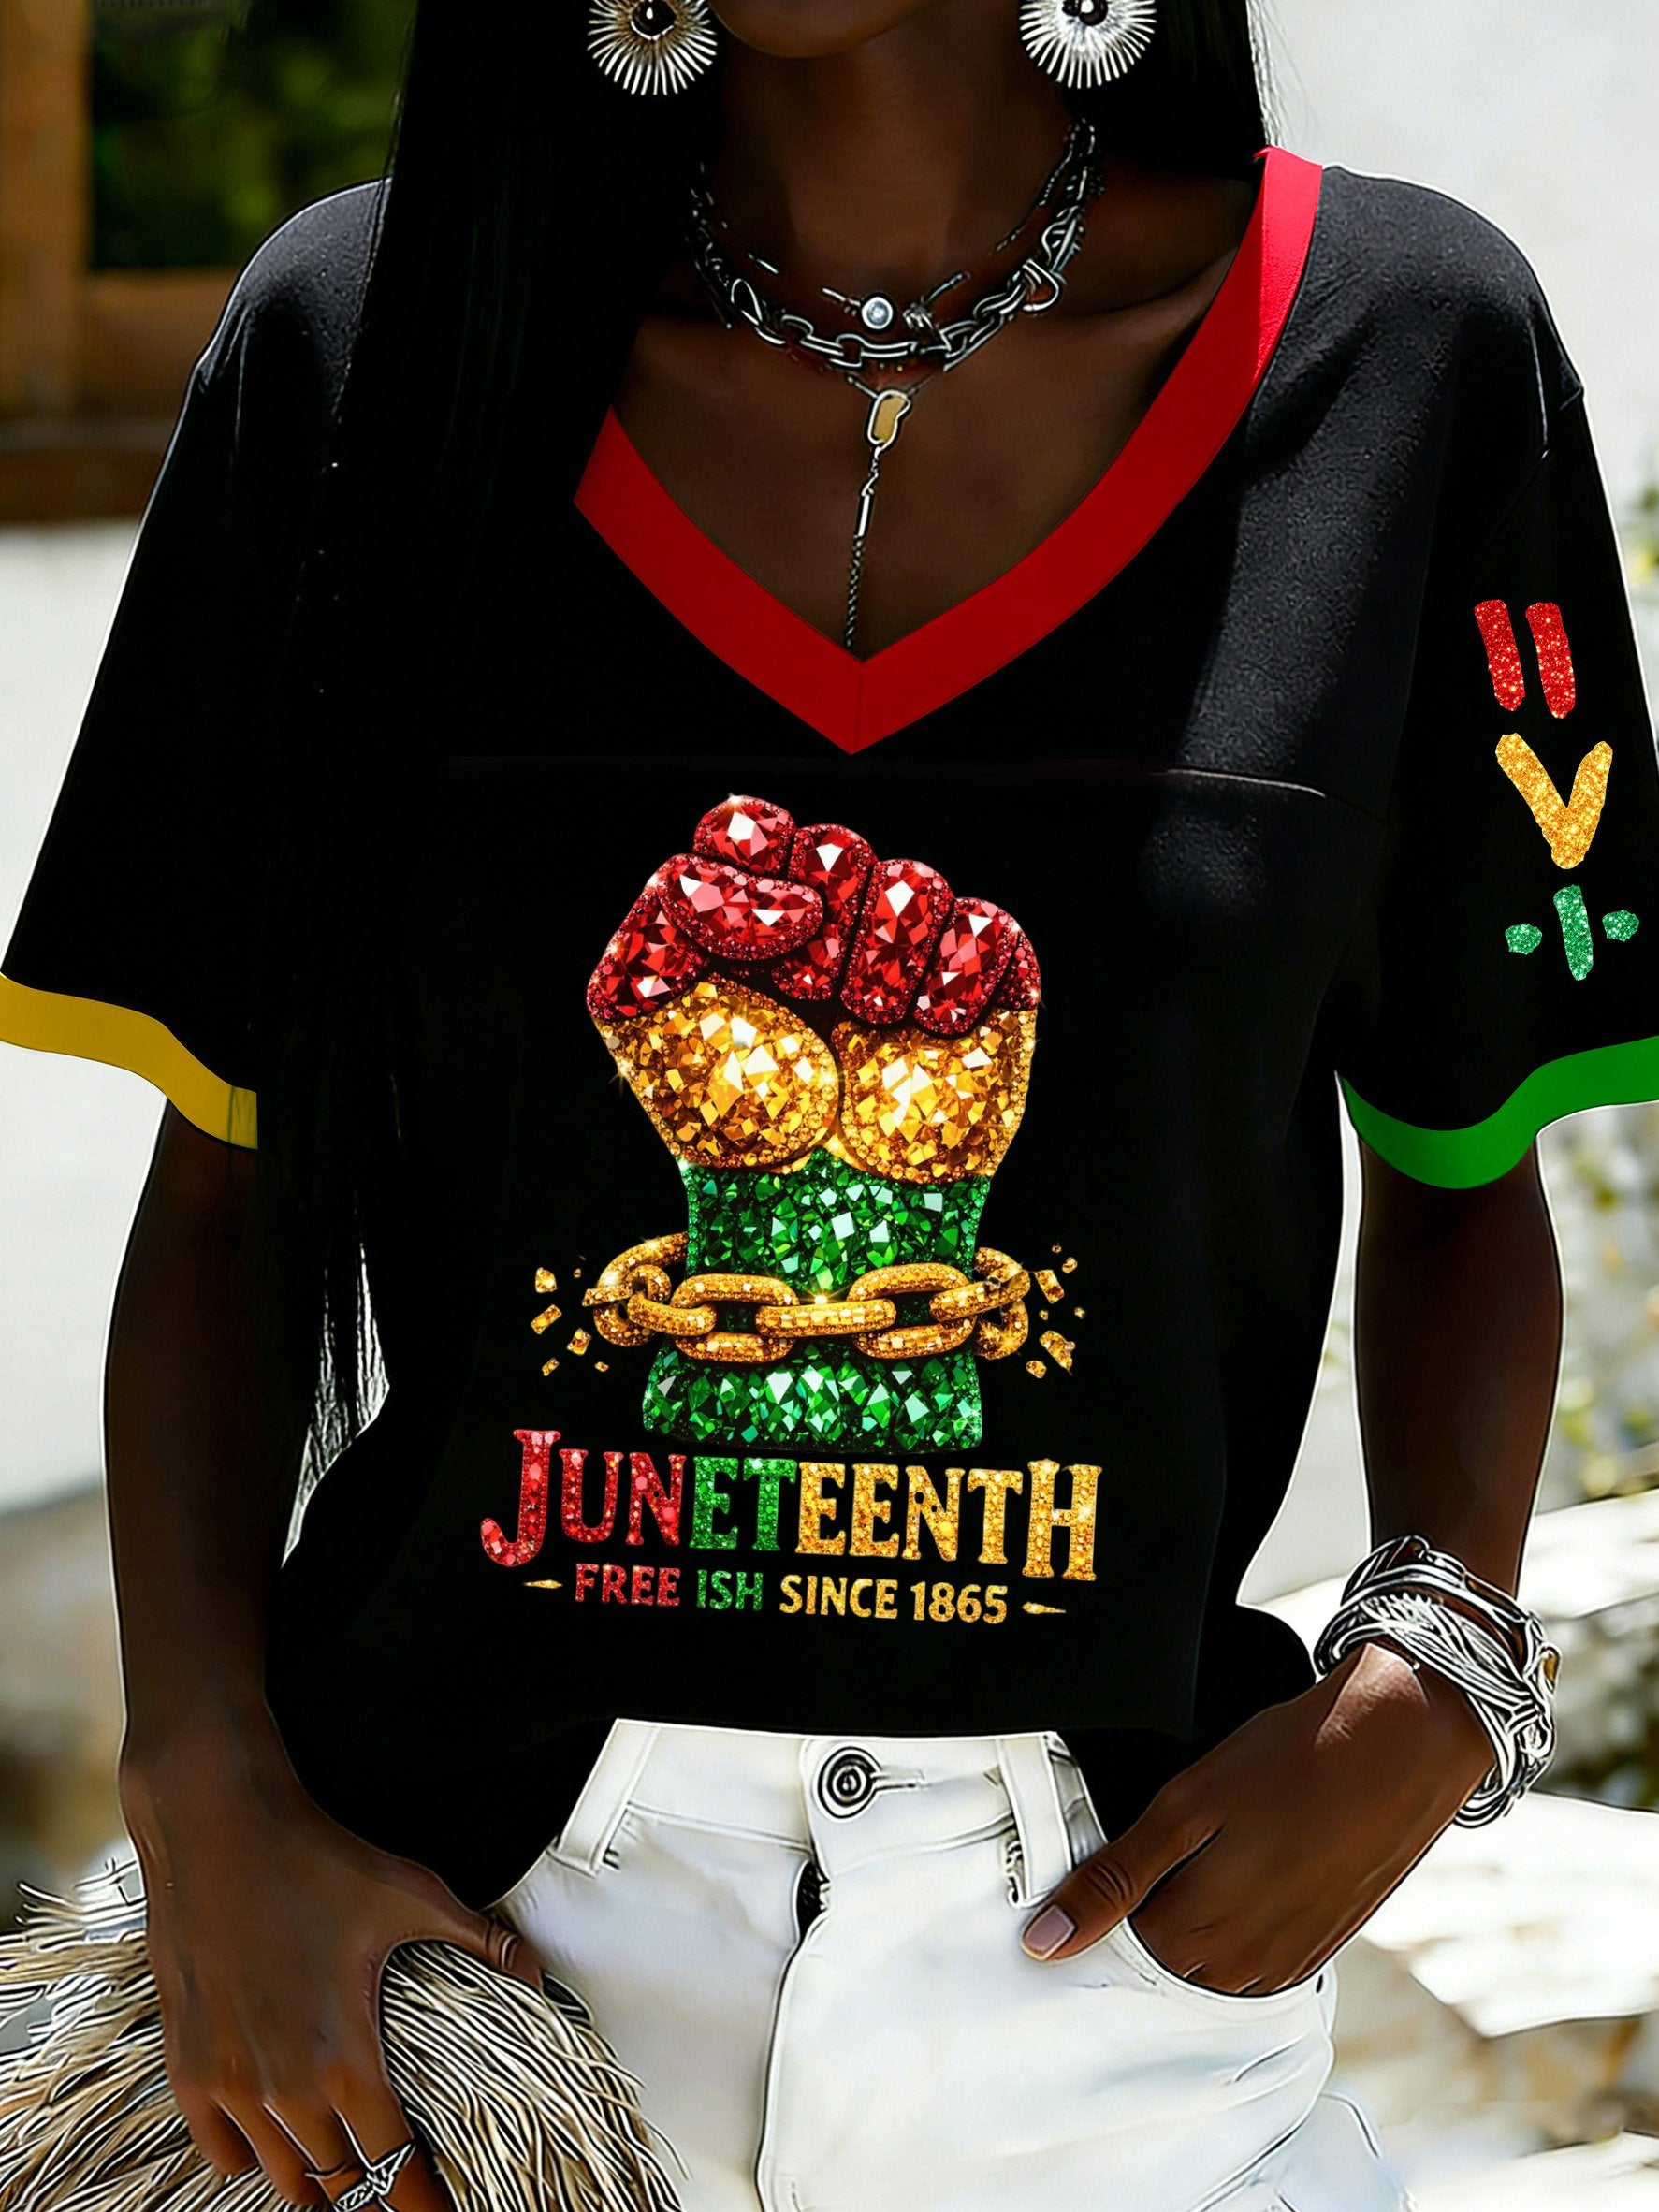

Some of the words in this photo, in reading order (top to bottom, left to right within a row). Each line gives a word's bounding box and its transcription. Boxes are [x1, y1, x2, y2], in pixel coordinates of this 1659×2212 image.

[480, 1428, 1103, 1582] JUNETEENTH
[574, 1563, 681, 1607] FREE
[696, 1569, 764, 1610] ISH
[779, 1574, 899, 1620] SINCE
[910, 1580, 1009, 1625] 1865
